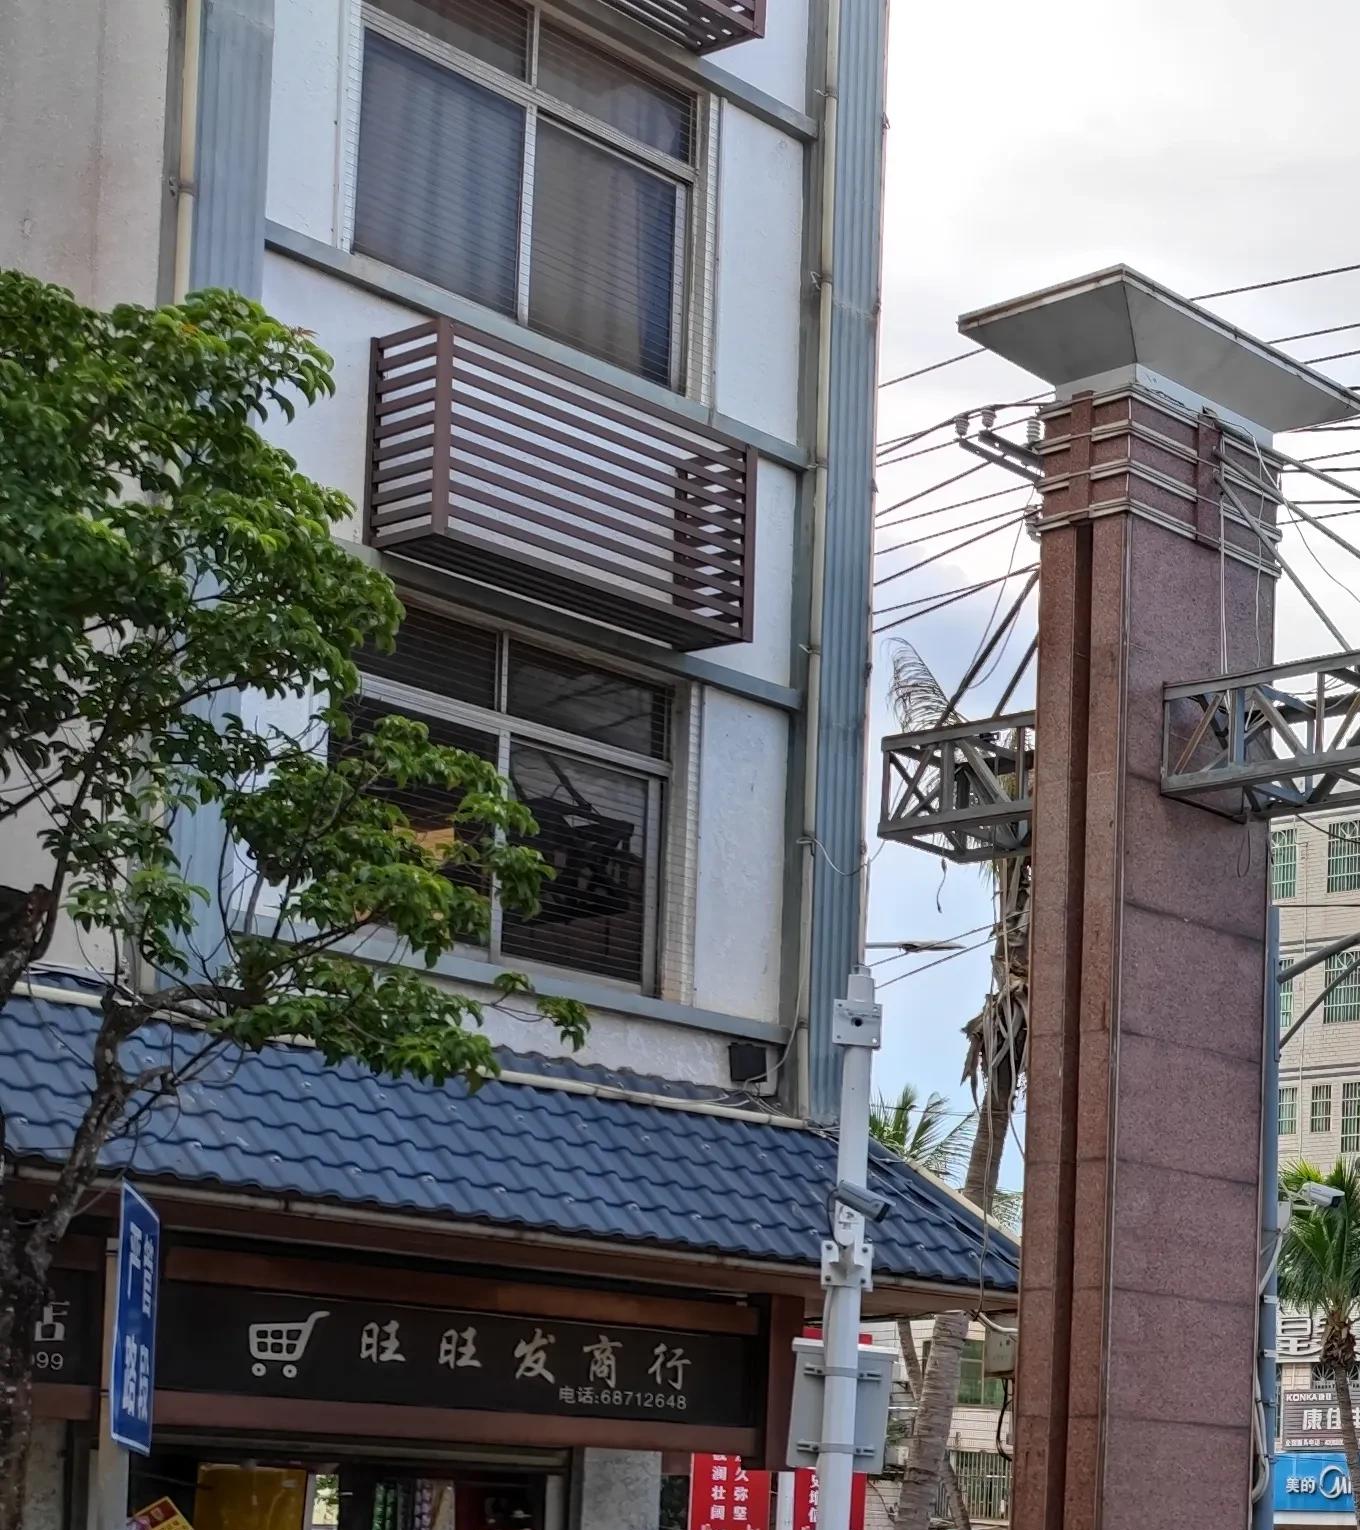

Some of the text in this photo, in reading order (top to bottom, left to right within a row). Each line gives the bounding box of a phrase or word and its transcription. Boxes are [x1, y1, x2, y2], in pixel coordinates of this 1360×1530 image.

[31, 1351, 64, 1370] 99
[360, 1319, 692, 1390] 旺旺发商行
[1286, 1477, 1316, 1494] 美的
